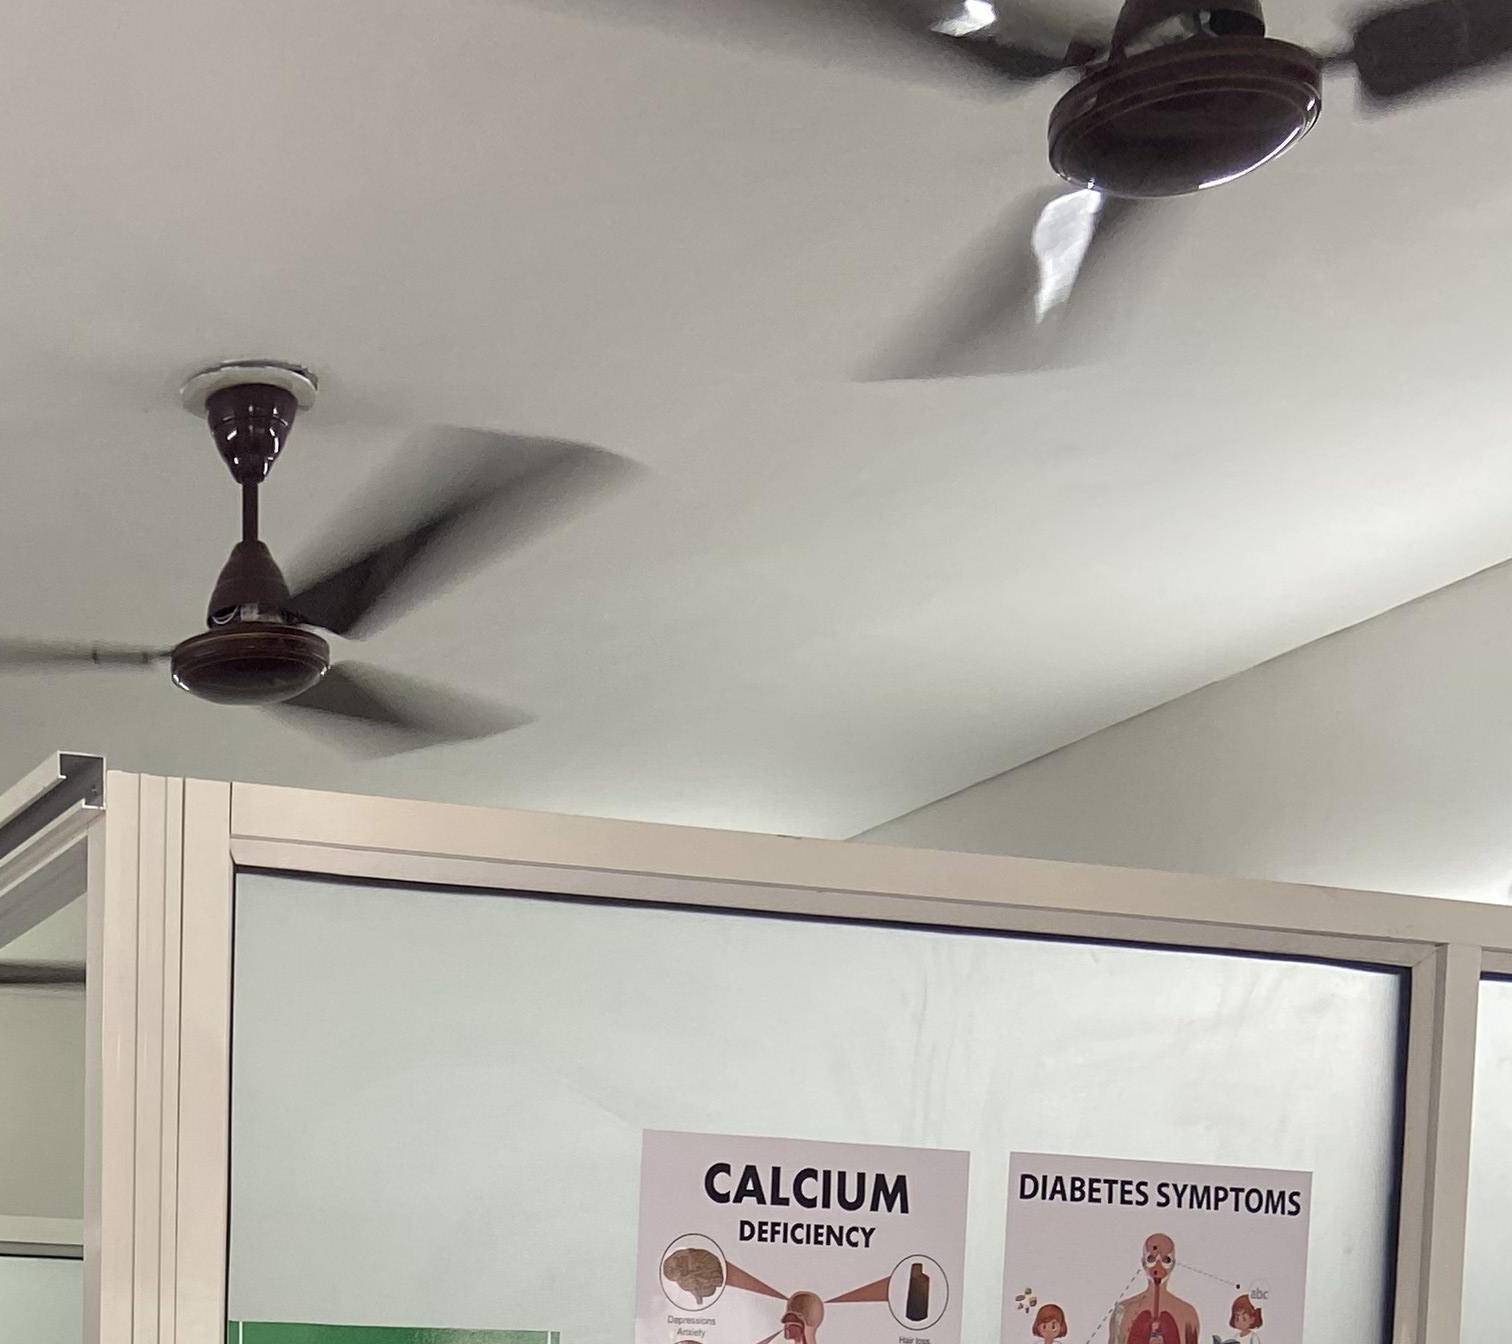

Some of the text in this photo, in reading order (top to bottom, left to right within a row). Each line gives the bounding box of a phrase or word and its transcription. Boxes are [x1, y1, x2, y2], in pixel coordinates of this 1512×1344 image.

[704, 1162, 909, 1214] CALCIUM
[1019, 1173, 1302, 1216] DIABETES SYMPTOMS
[739, 1220, 875, 1248] DEFICIENCY
[1251, 1288, 1268, 1299] abc
